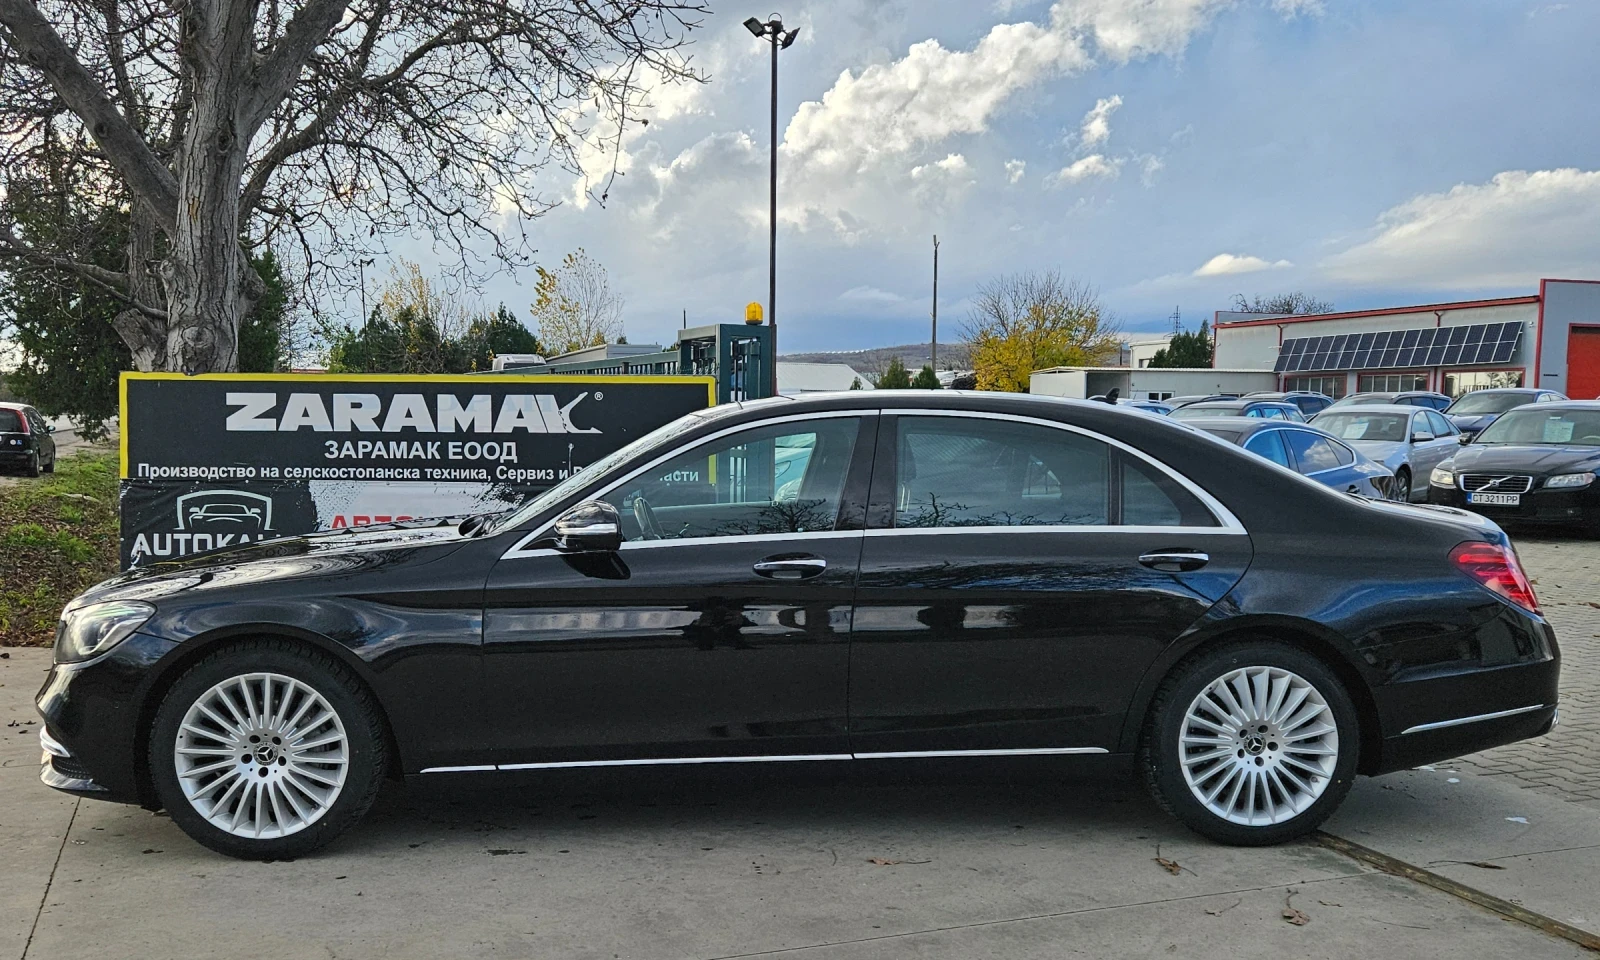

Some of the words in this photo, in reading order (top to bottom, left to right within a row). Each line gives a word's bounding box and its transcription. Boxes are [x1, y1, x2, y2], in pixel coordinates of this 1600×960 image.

[226, 391, 604, 434] ZARAMAK
[324, 440, 441, 460] ЗАРАМАК
[448, 441, 518, 463] ЕООД
[138, 463, 256, 480] Производство
[261, 467, 280, 478] на
[284, 467, 421, 479] селскостопанска
[425, 468, 491, 481] техника,
[496, 465, 555, 482] Сервиз
[558, 469, 568, 480] и
[660, 470, 699, 482] асти
[130, 533, 281, 556] AUTOK
